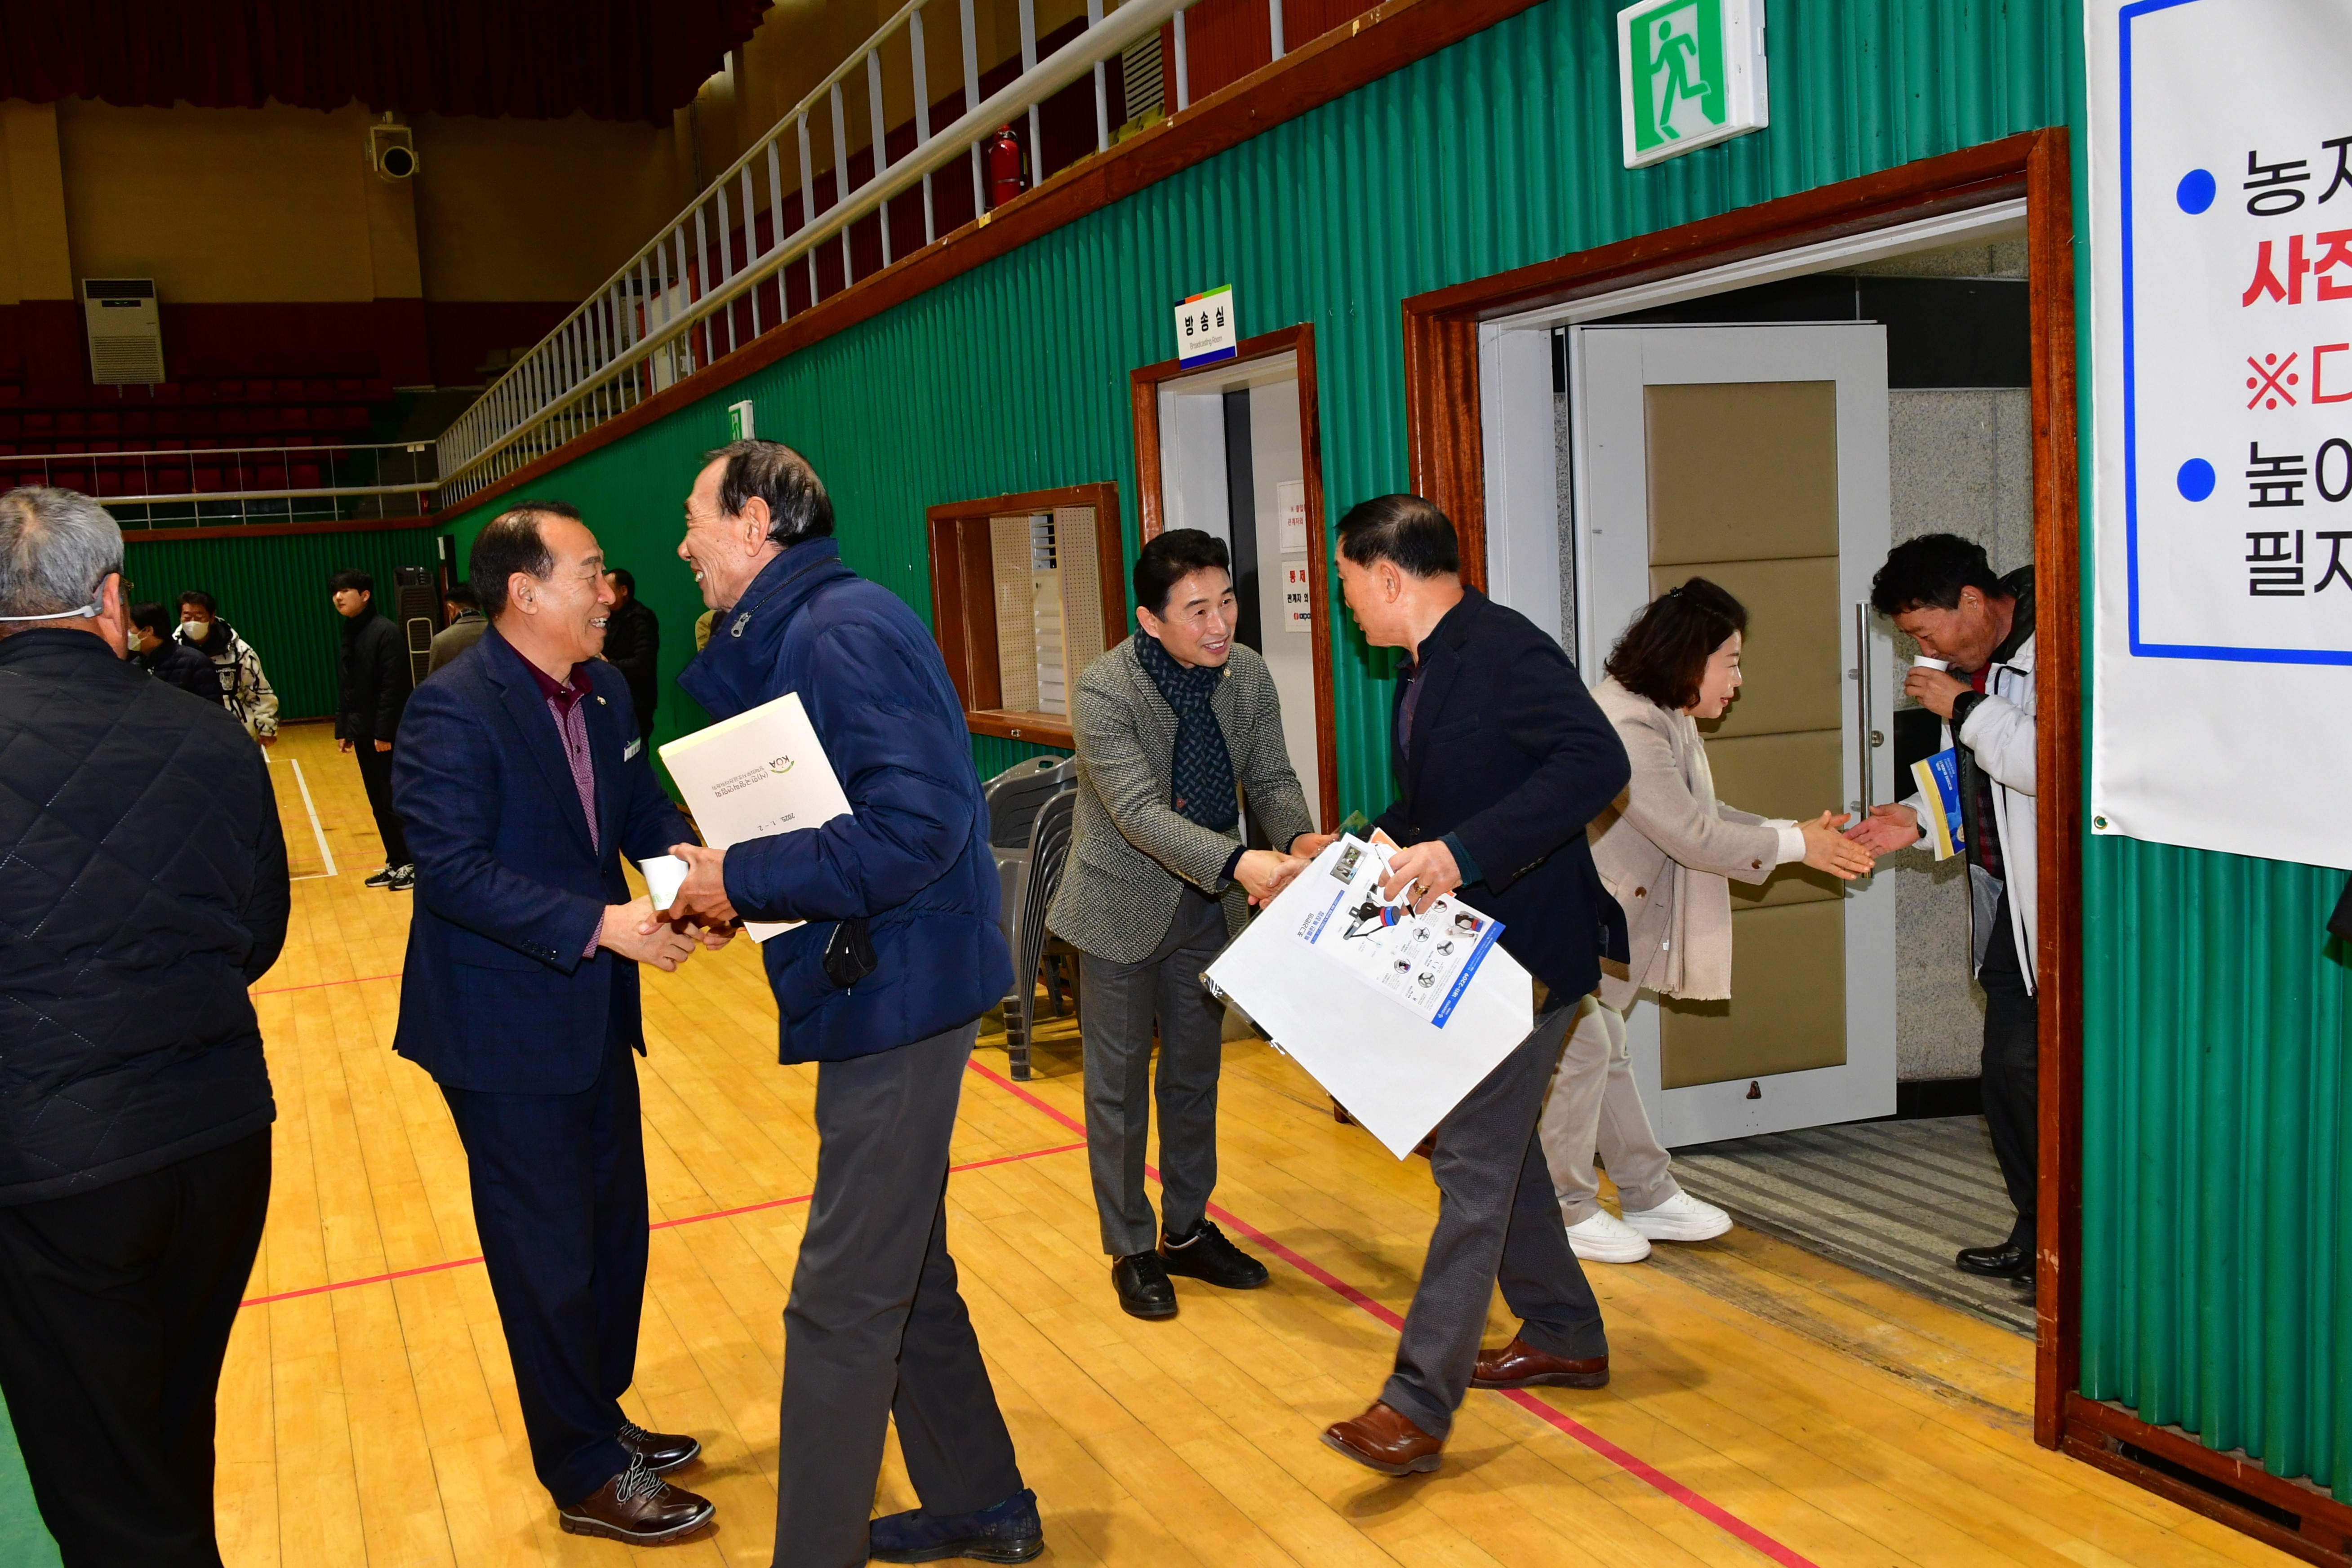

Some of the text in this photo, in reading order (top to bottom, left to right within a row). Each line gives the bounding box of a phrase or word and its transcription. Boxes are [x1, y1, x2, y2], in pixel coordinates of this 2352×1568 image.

[1185, 306, 1224, 336] 방송실
[1190, 336, 1223, 350] Broadcasting Room
[1287, 593, 1309, 604] 관계자 외
[769, 755, 790, 768] KOA
[1451, 973, 1469, 998] 1811-2209
